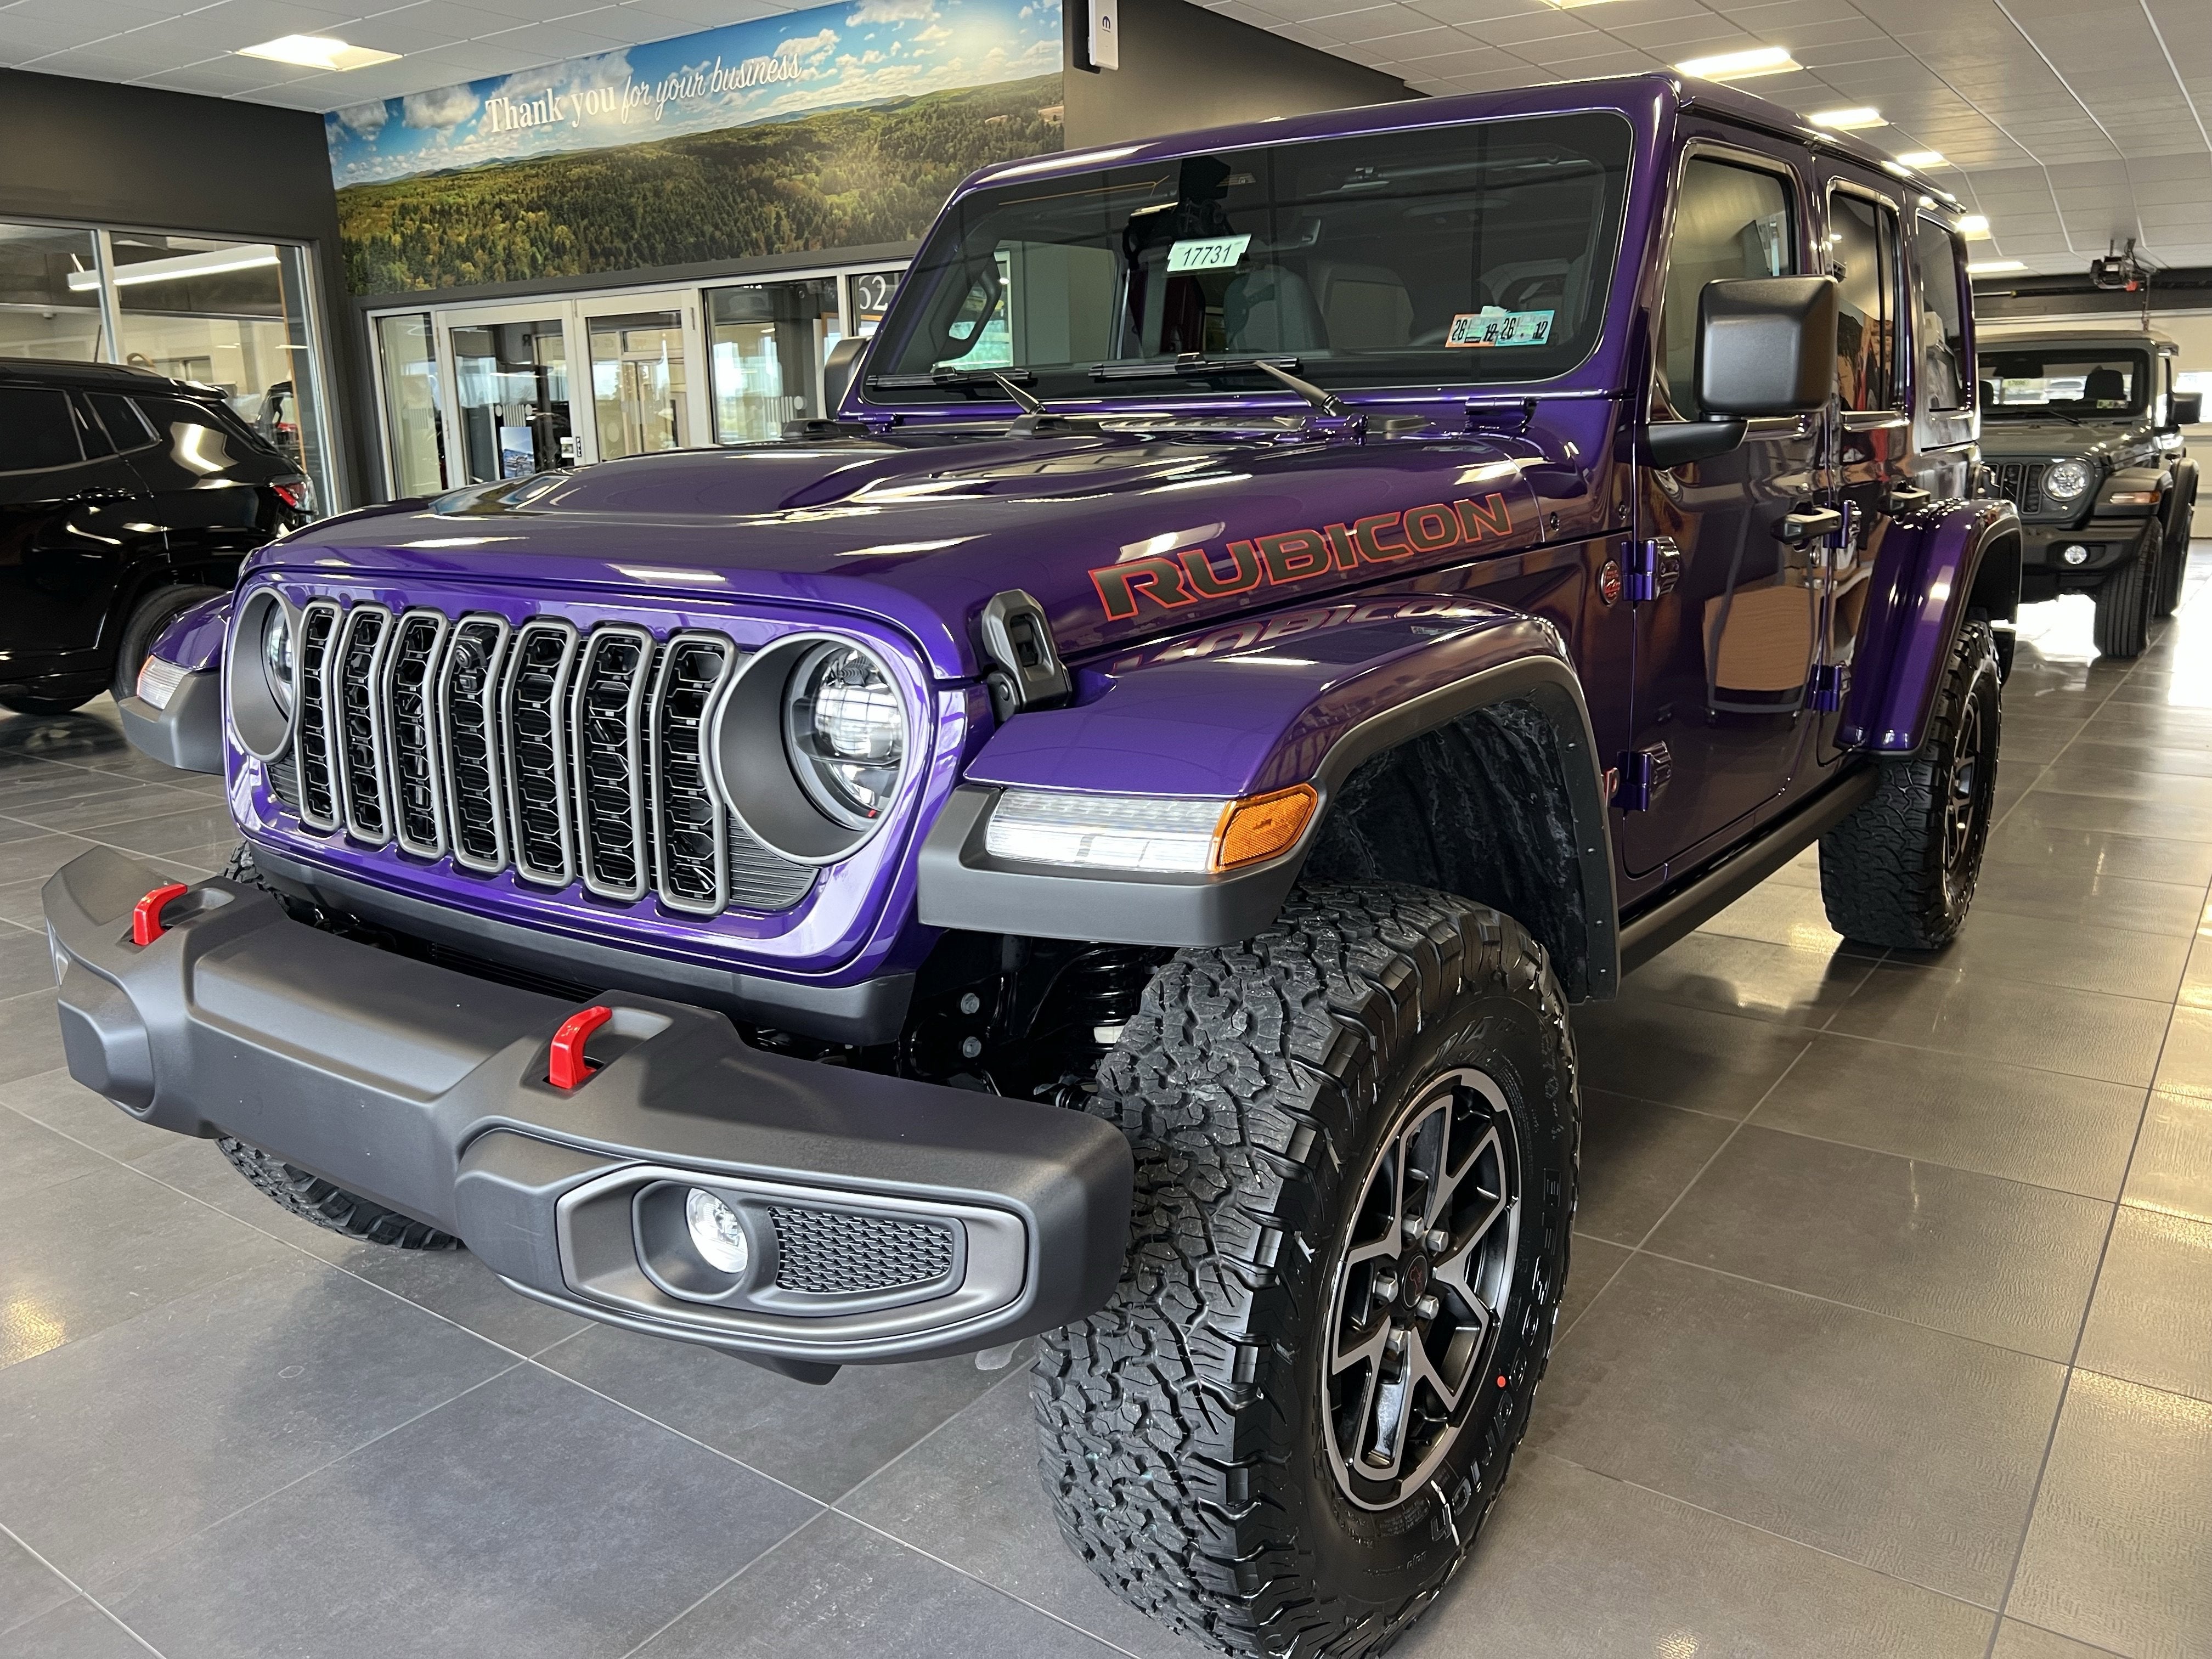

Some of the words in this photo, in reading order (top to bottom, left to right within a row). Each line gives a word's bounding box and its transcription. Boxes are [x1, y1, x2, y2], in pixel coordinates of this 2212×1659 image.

[485, 88, 563, 133] Thank
[571, 86, 616, 128] you
[620, 75, 652, 125] for
[656, 75, 706, 121] your
[710, 53, 802, 93] business
[1183, 244, 1232, 266] 17731
[1452, 319, 1468, 341] 26
[1500, 318, 1516, 340] 26
[1533, 321, 1548, 340] 12
[1088, 493, 1512, 622] RUBICON
